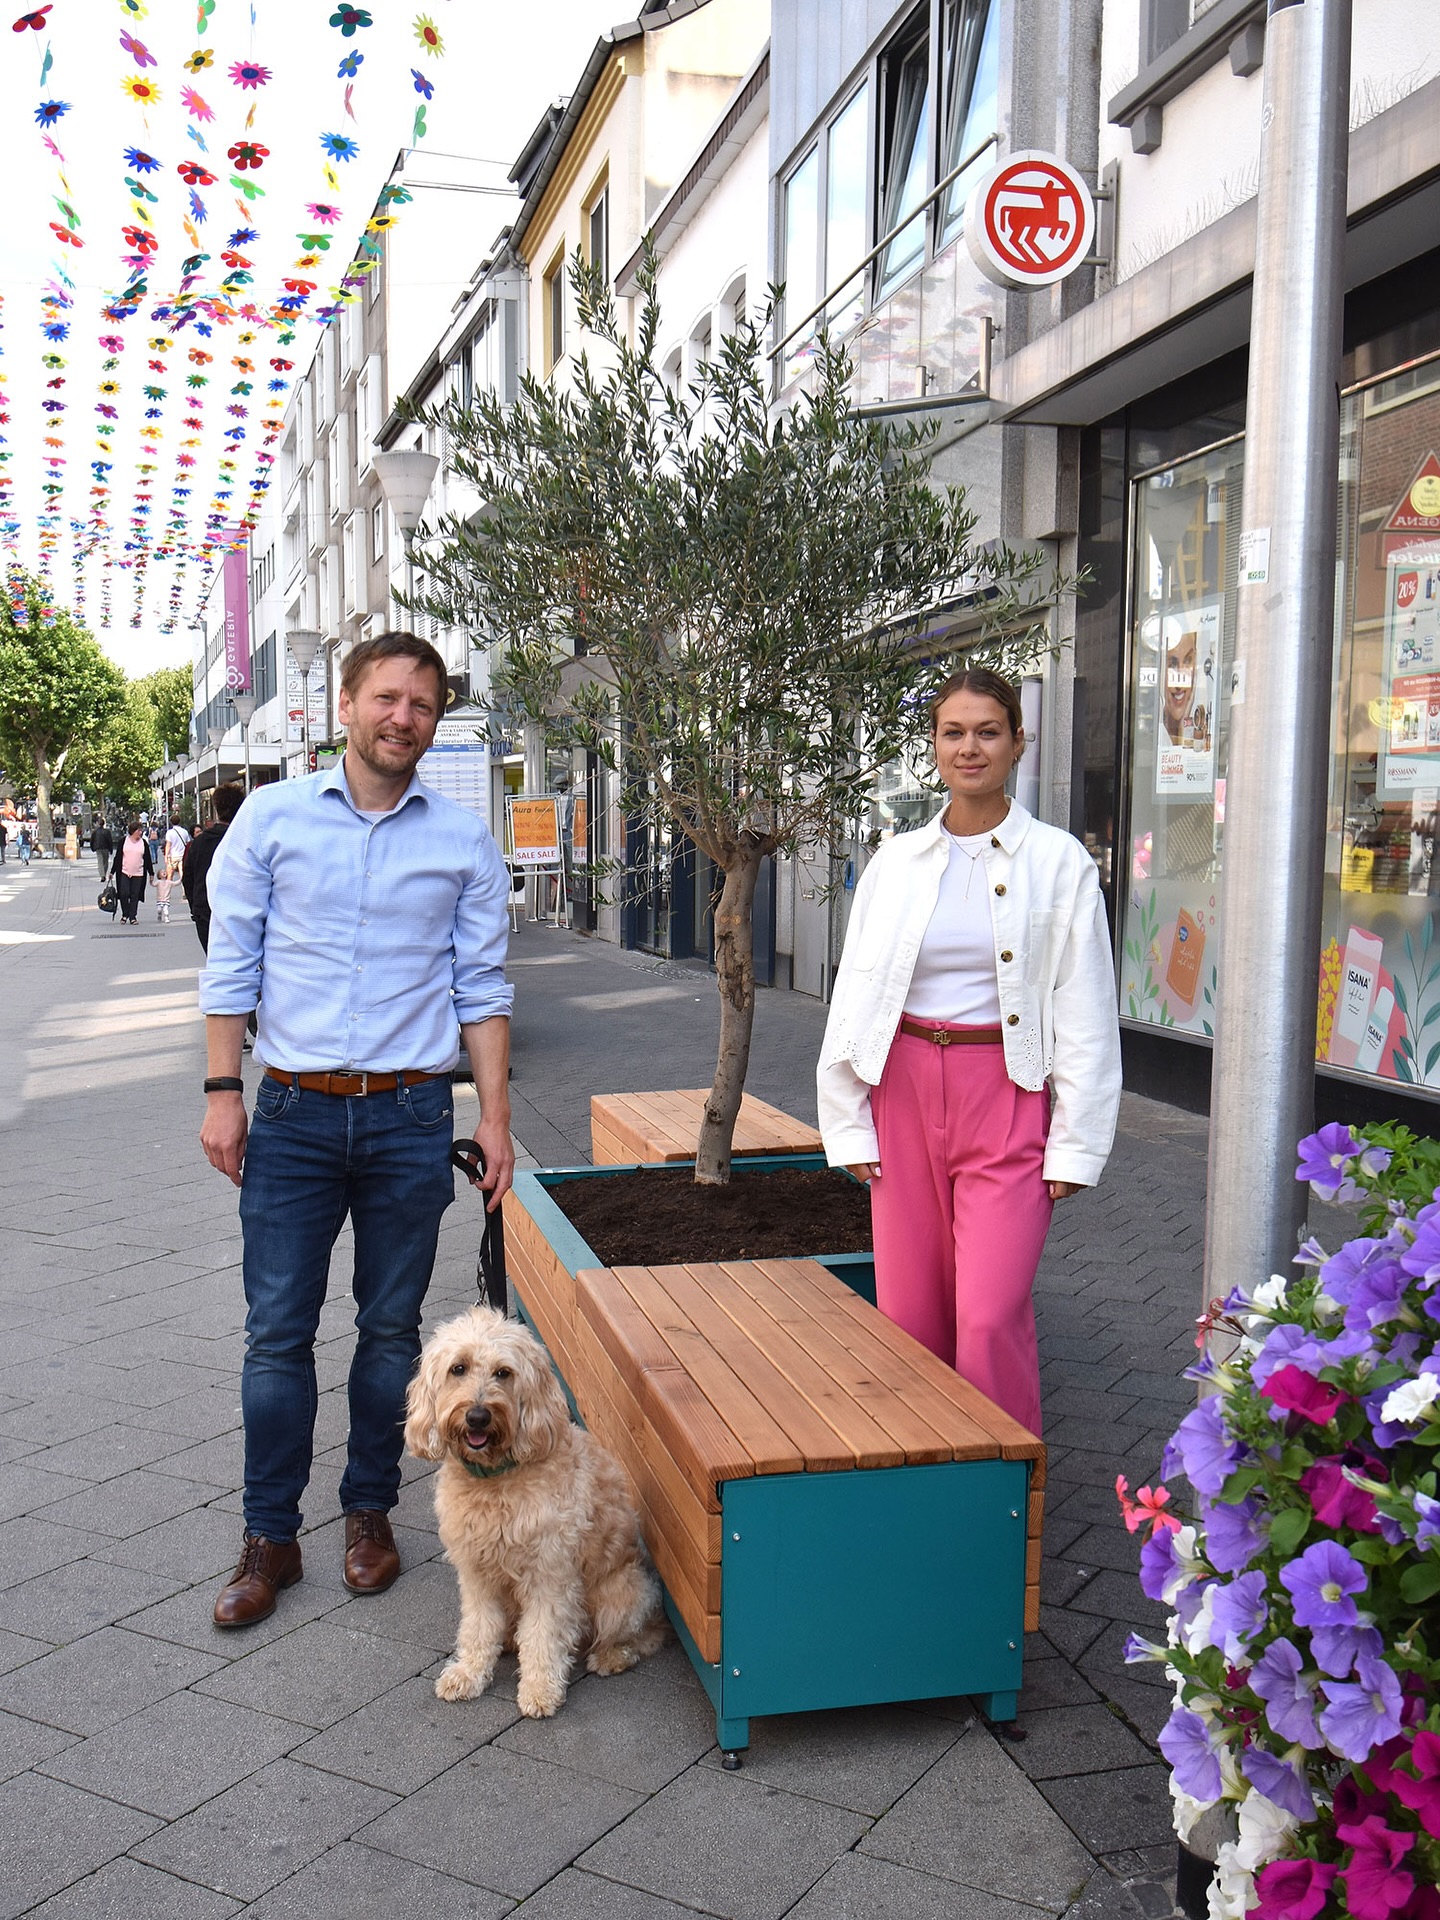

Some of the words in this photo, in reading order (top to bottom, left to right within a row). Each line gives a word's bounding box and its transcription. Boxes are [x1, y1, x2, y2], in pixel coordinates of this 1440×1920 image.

[1398, 581, 1416, 599] 20%
[1161, 754, 1182, 764] BEAUTY
[516, 851, 535, 859] SALE
[537, 850, 556, 858] SALE
